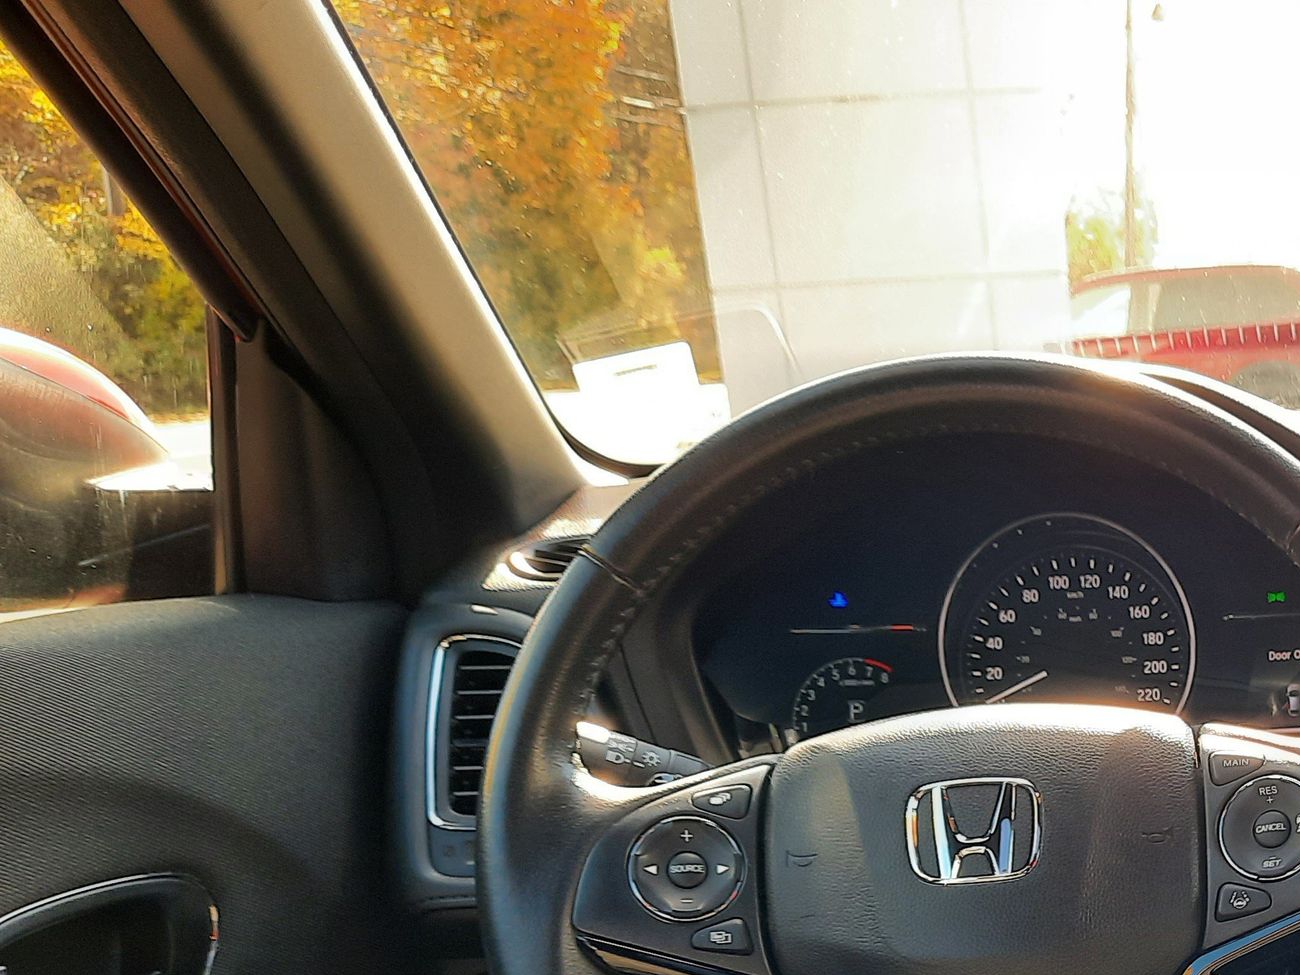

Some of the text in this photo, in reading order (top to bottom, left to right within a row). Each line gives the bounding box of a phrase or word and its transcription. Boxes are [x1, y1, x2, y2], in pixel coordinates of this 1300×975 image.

[1048, 576, 1069, 589] 100
[1080, 575, 1100, 588] 120
[1022, 589, 1039, 602] 80
[1108, 586, 1129, 599] 140
[998, 609, 1015, 622] 60
[1129, 605, 1150, 619] 160
[985, 636, 1002, 650] 40
[1143, 632, 1164, 645] 180
[1268, 650, 1291, 661] Door
[848, 666, 856, 676] 6
[865, 666, 873, 677] 7
[1144, 661, 1167, 674] 200
[832, 669, 840, 681] 5
[985, 668, 1002, 680] 20
[817, 677, 825, 687] 4
[808, 689, 816, 701] 3
[1137, 688, 1160, 702] 220
[801, 705, 809, 717] 2
[850, 702, 864, 720] P
[1223, 758, 1249, 767] MAIN
[1259, 786, 1277, 795] RES
[1255, 823, 1286, 833] CANCEL
[670, 864, 705, 873] SOURCE
[1263, 859, 1281, 868] SET
